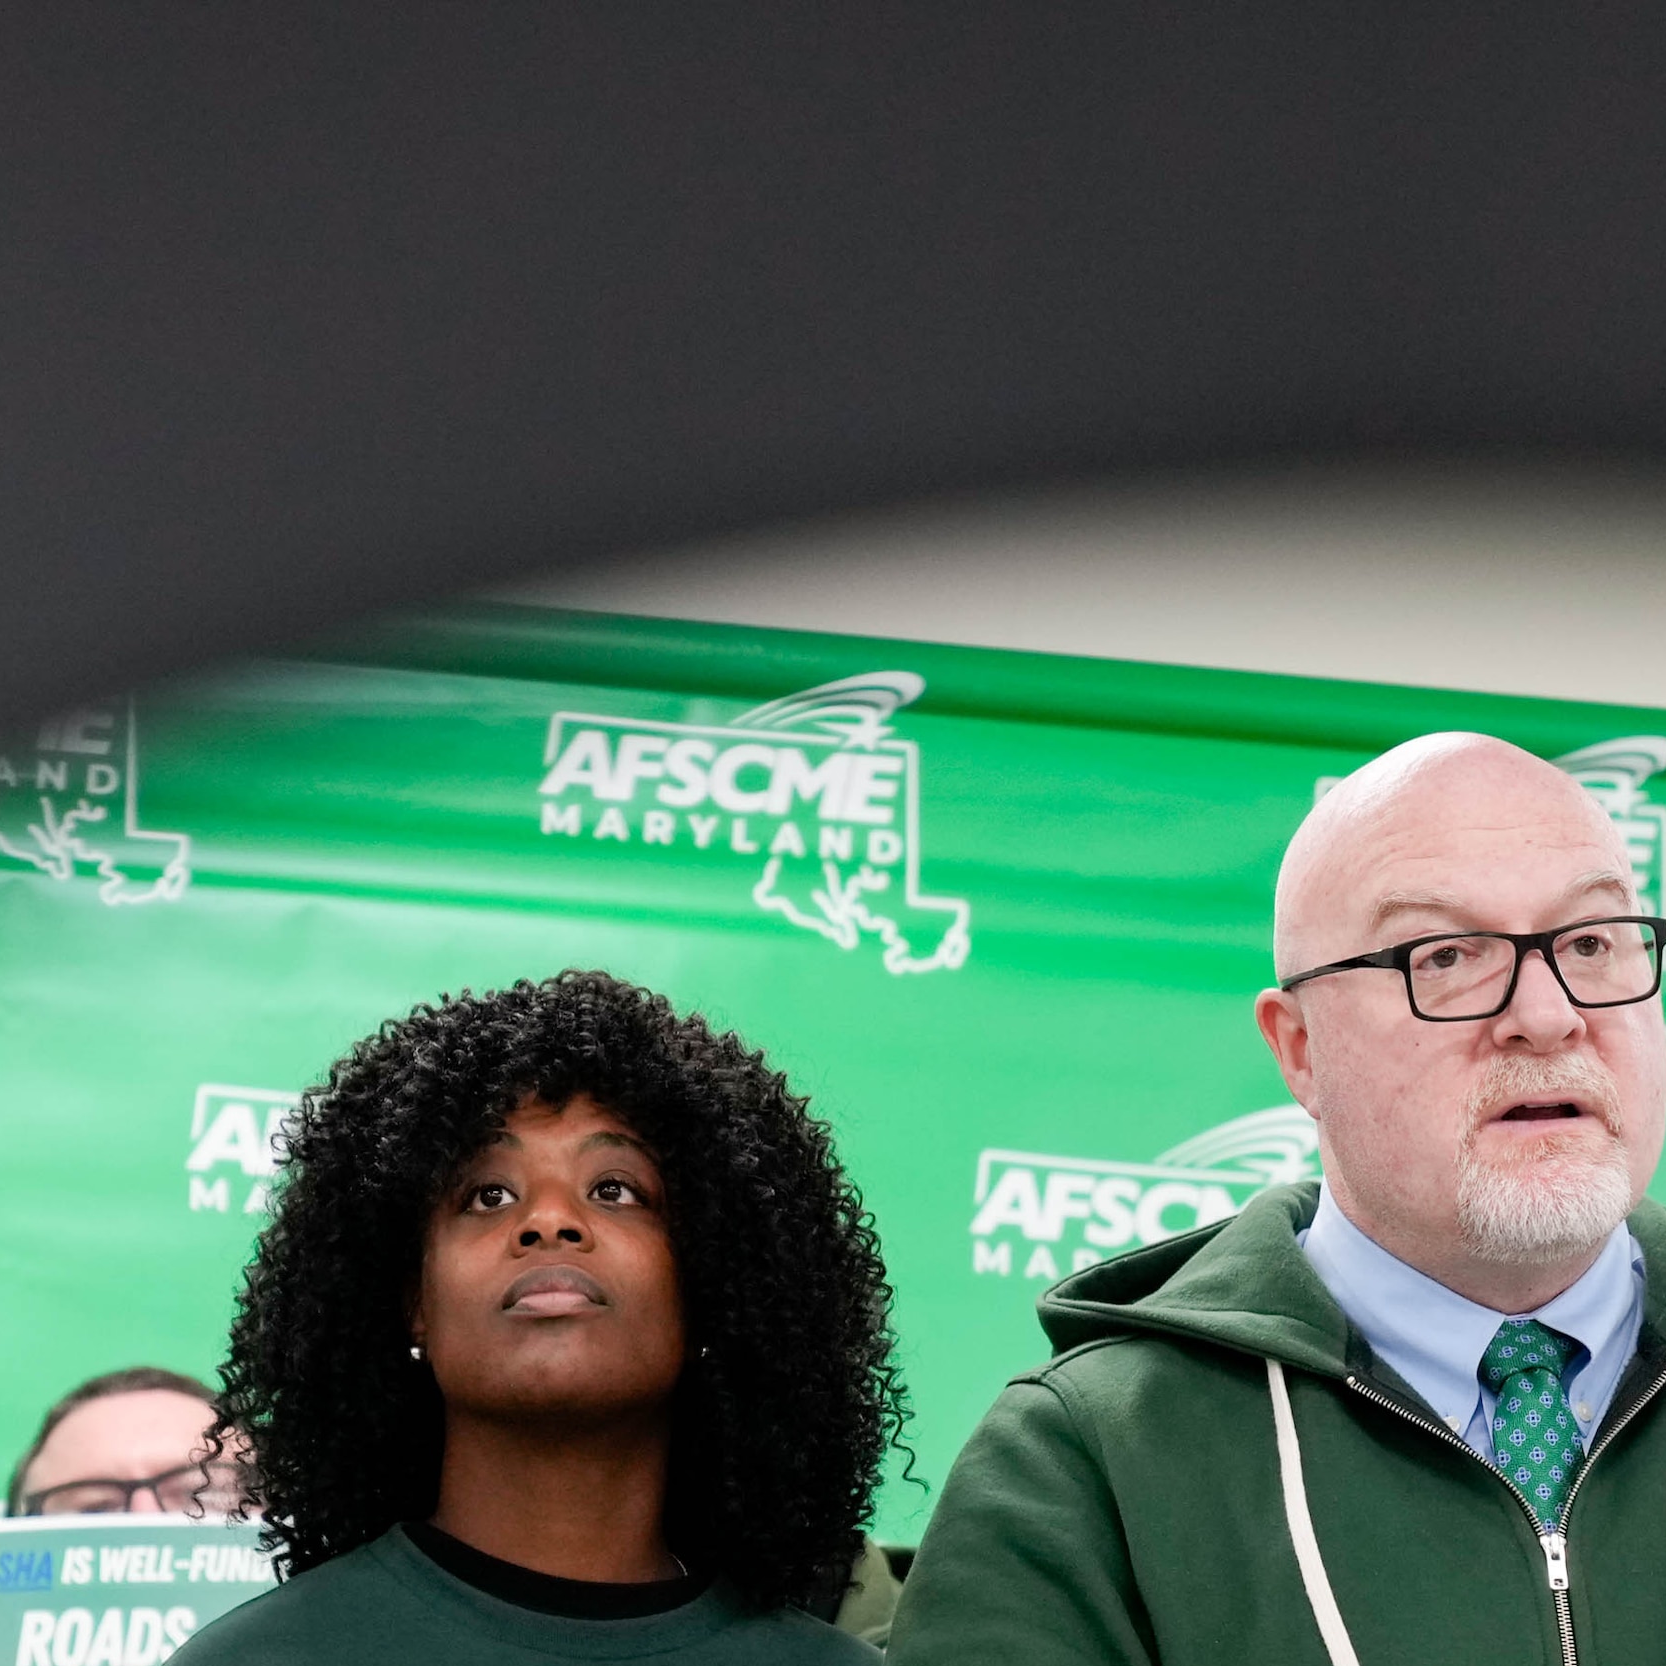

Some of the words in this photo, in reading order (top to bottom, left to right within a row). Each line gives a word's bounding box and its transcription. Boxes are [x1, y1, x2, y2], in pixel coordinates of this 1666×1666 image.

[538, 729, 905, 824] AFSCME
[540, 802, 904, 864] MARYLAND
[61, 1546, 96, 1585] IS
